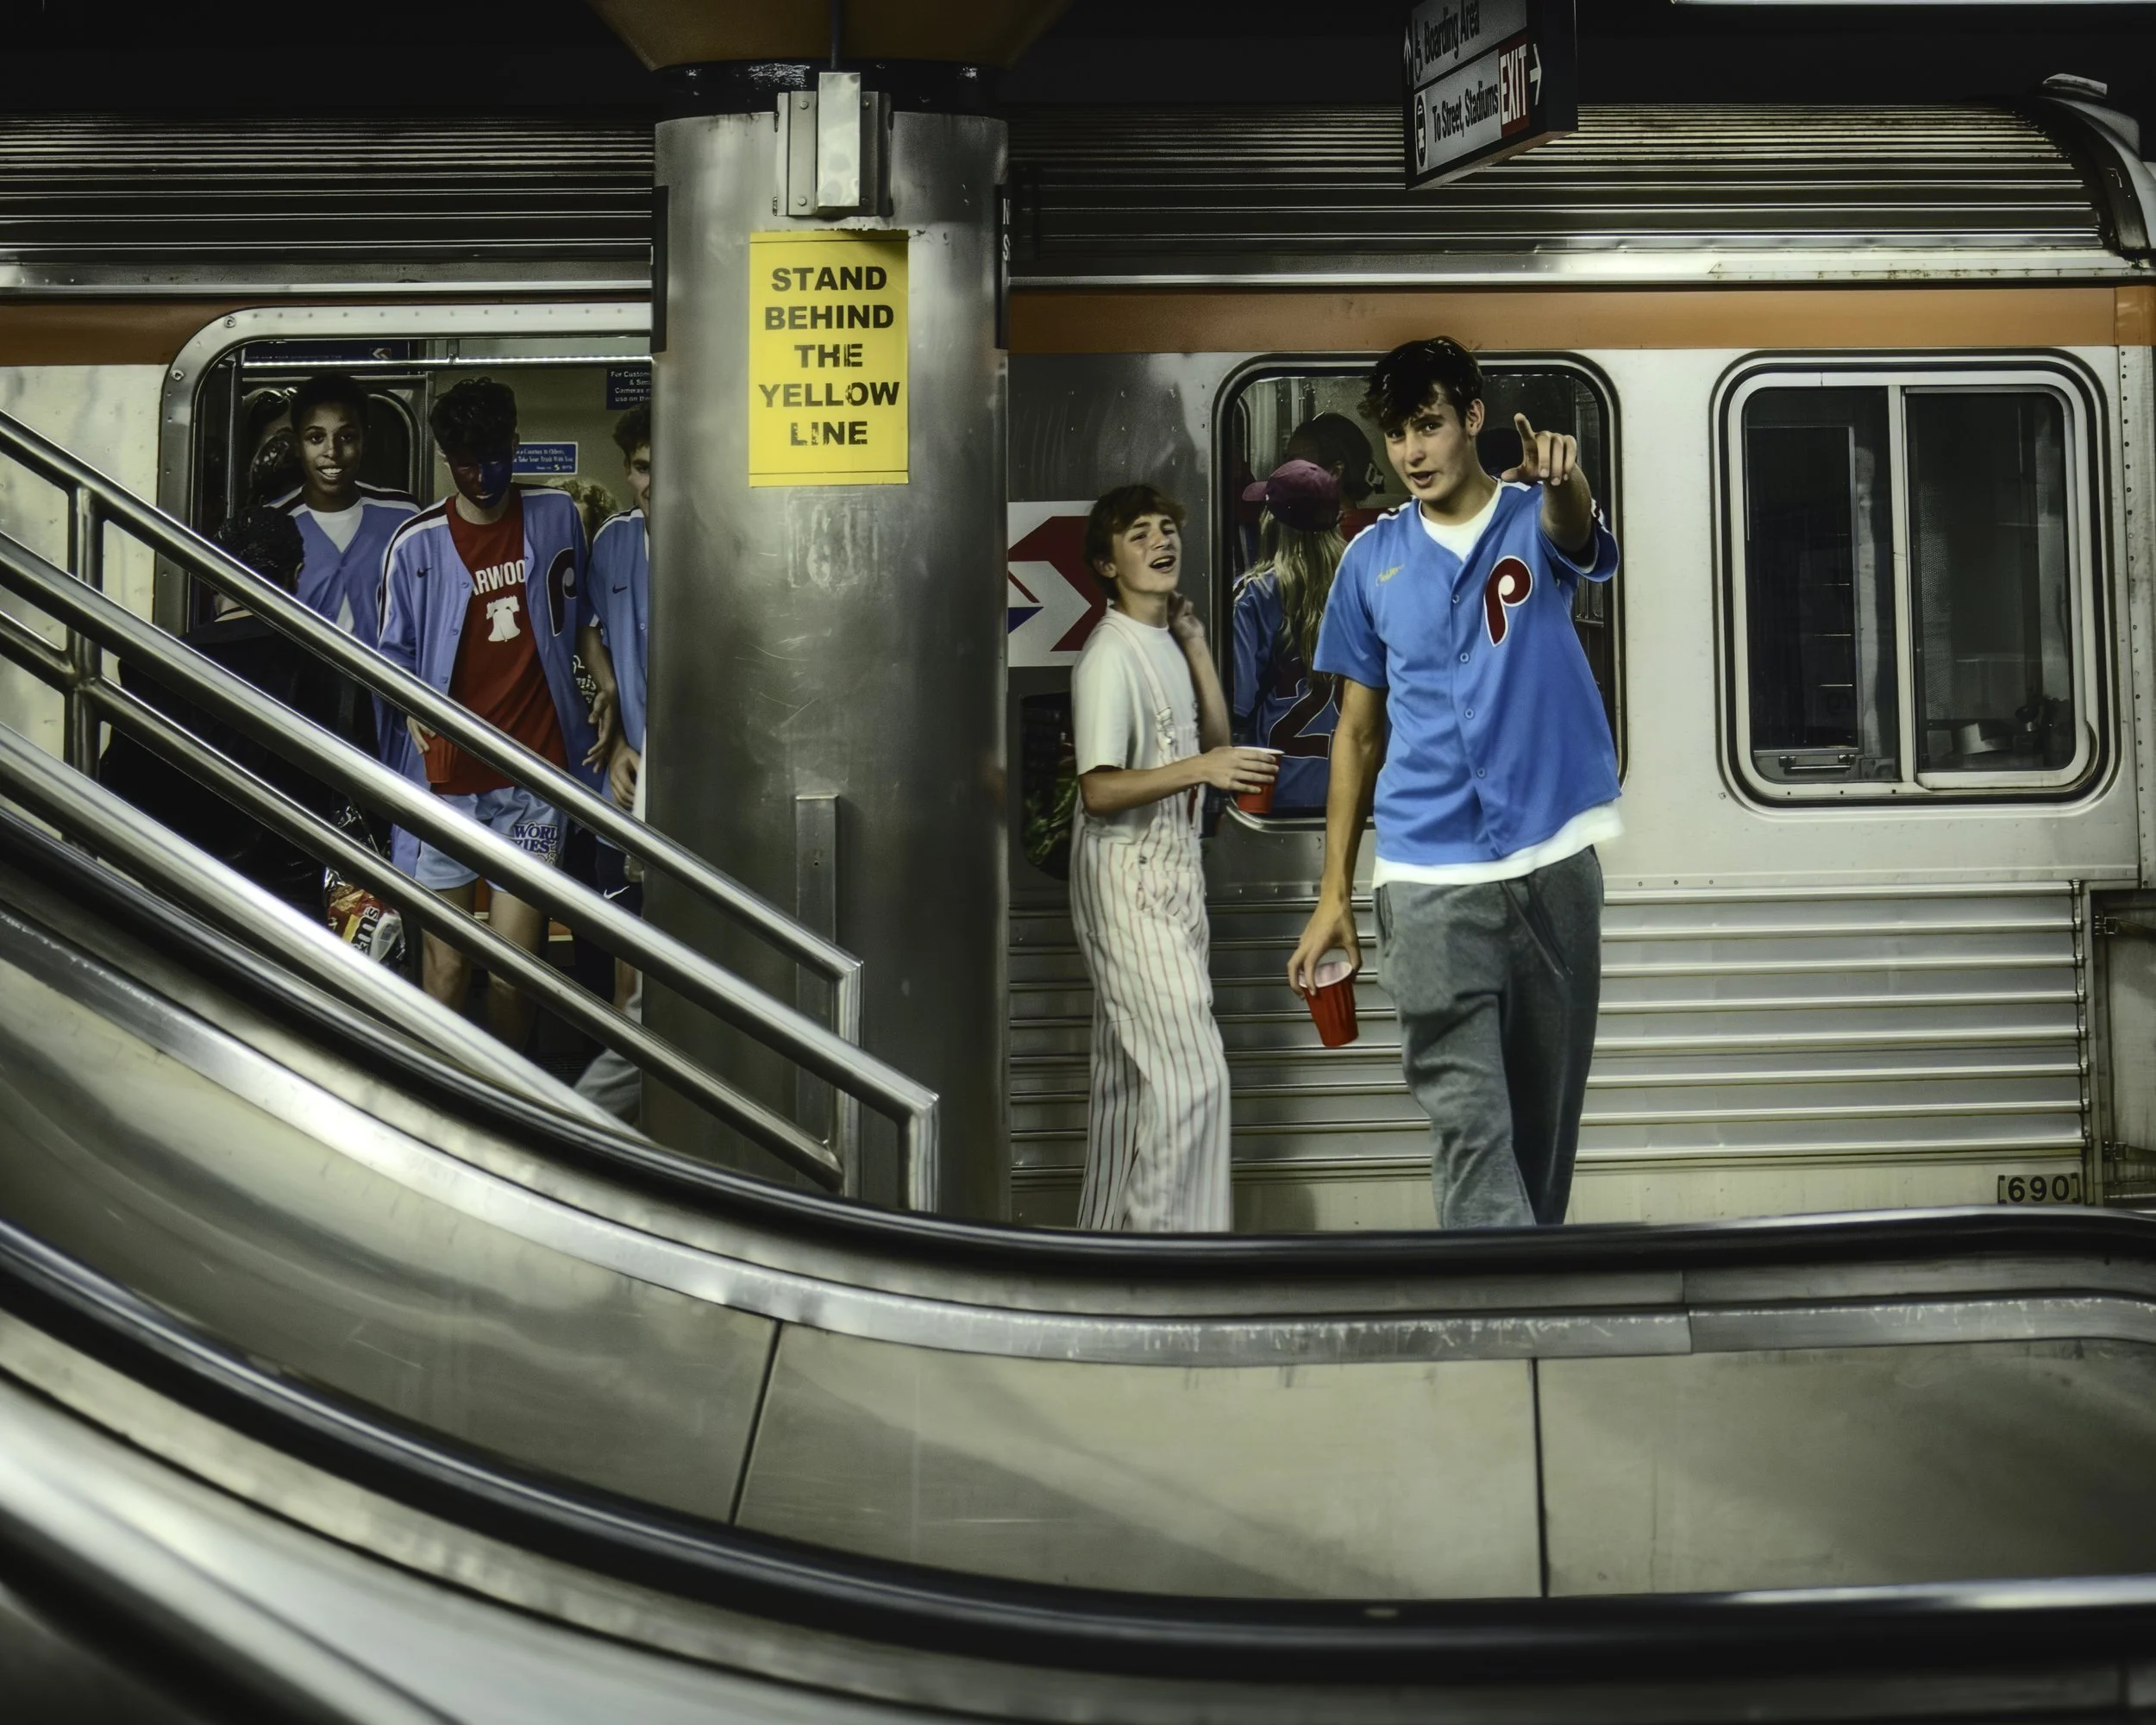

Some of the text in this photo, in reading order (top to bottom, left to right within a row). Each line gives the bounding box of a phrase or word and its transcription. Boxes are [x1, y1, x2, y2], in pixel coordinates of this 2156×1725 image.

[1424, 0, 1480, 65] Boarding Area
[1500, 44, 1527, 125] EXIT
[1432, 80, 1499, 143] To Street, Stadiums
[771, 266, 887, 292] STAND
[765, 304, 894, 330] BEHIND
[793, 343, 863, 368] THE
[758, 381, 900, 408] YELLOW
[790, 421, 868, 446] LINE
